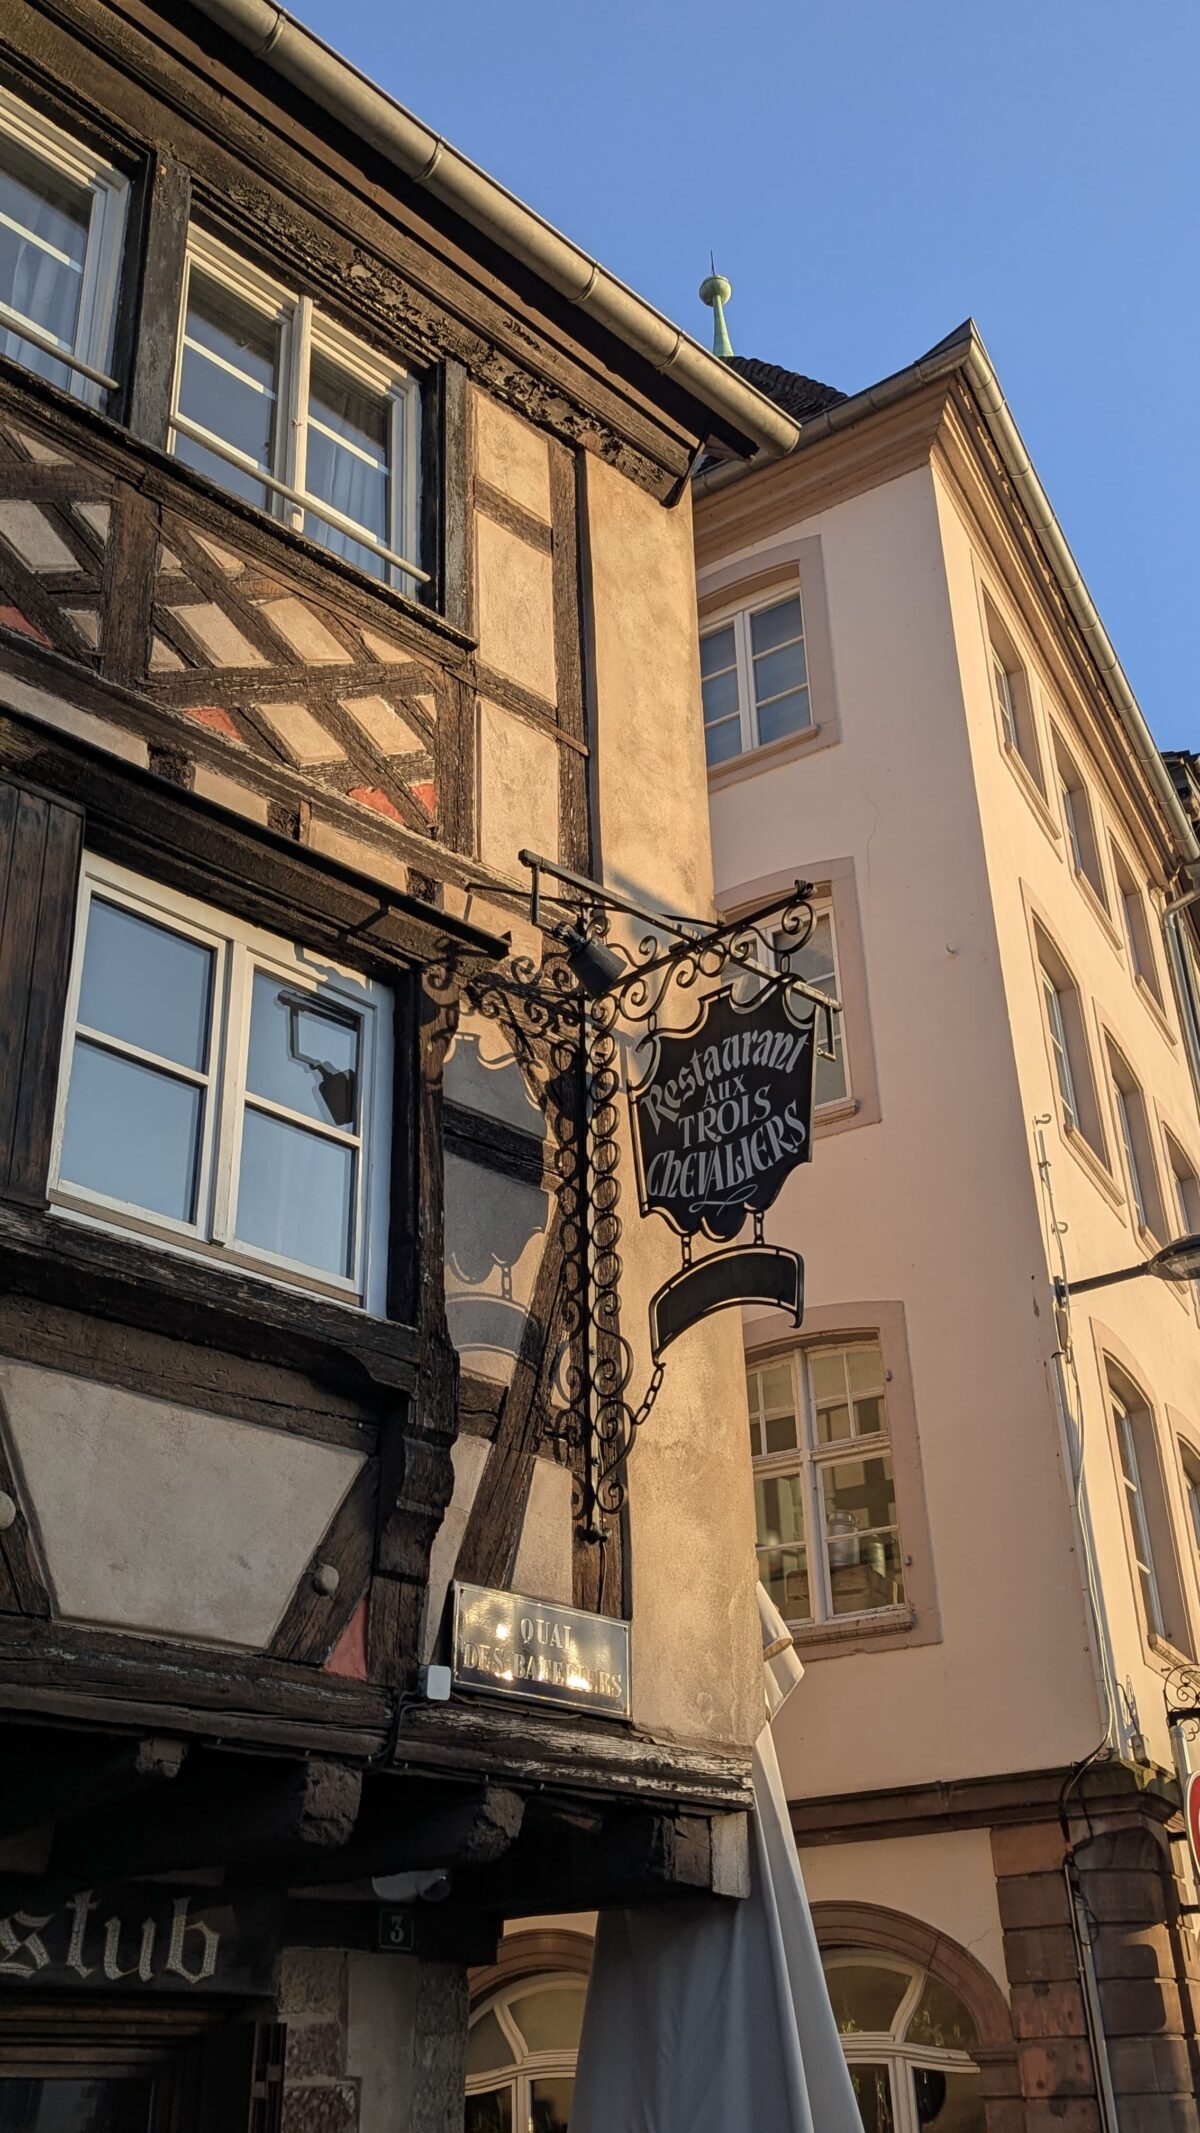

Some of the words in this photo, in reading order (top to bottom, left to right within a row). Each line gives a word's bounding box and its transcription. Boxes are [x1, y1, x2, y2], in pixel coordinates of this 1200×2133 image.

[640, 1029, 809, 1136] Restaurant
[678, 1084, 771, 1149] TROIS
[520, 1618, 572, 1651] QUAI
[462, 1641, 505, 1675] DES
[390, 1915, 404, 1943] 3
